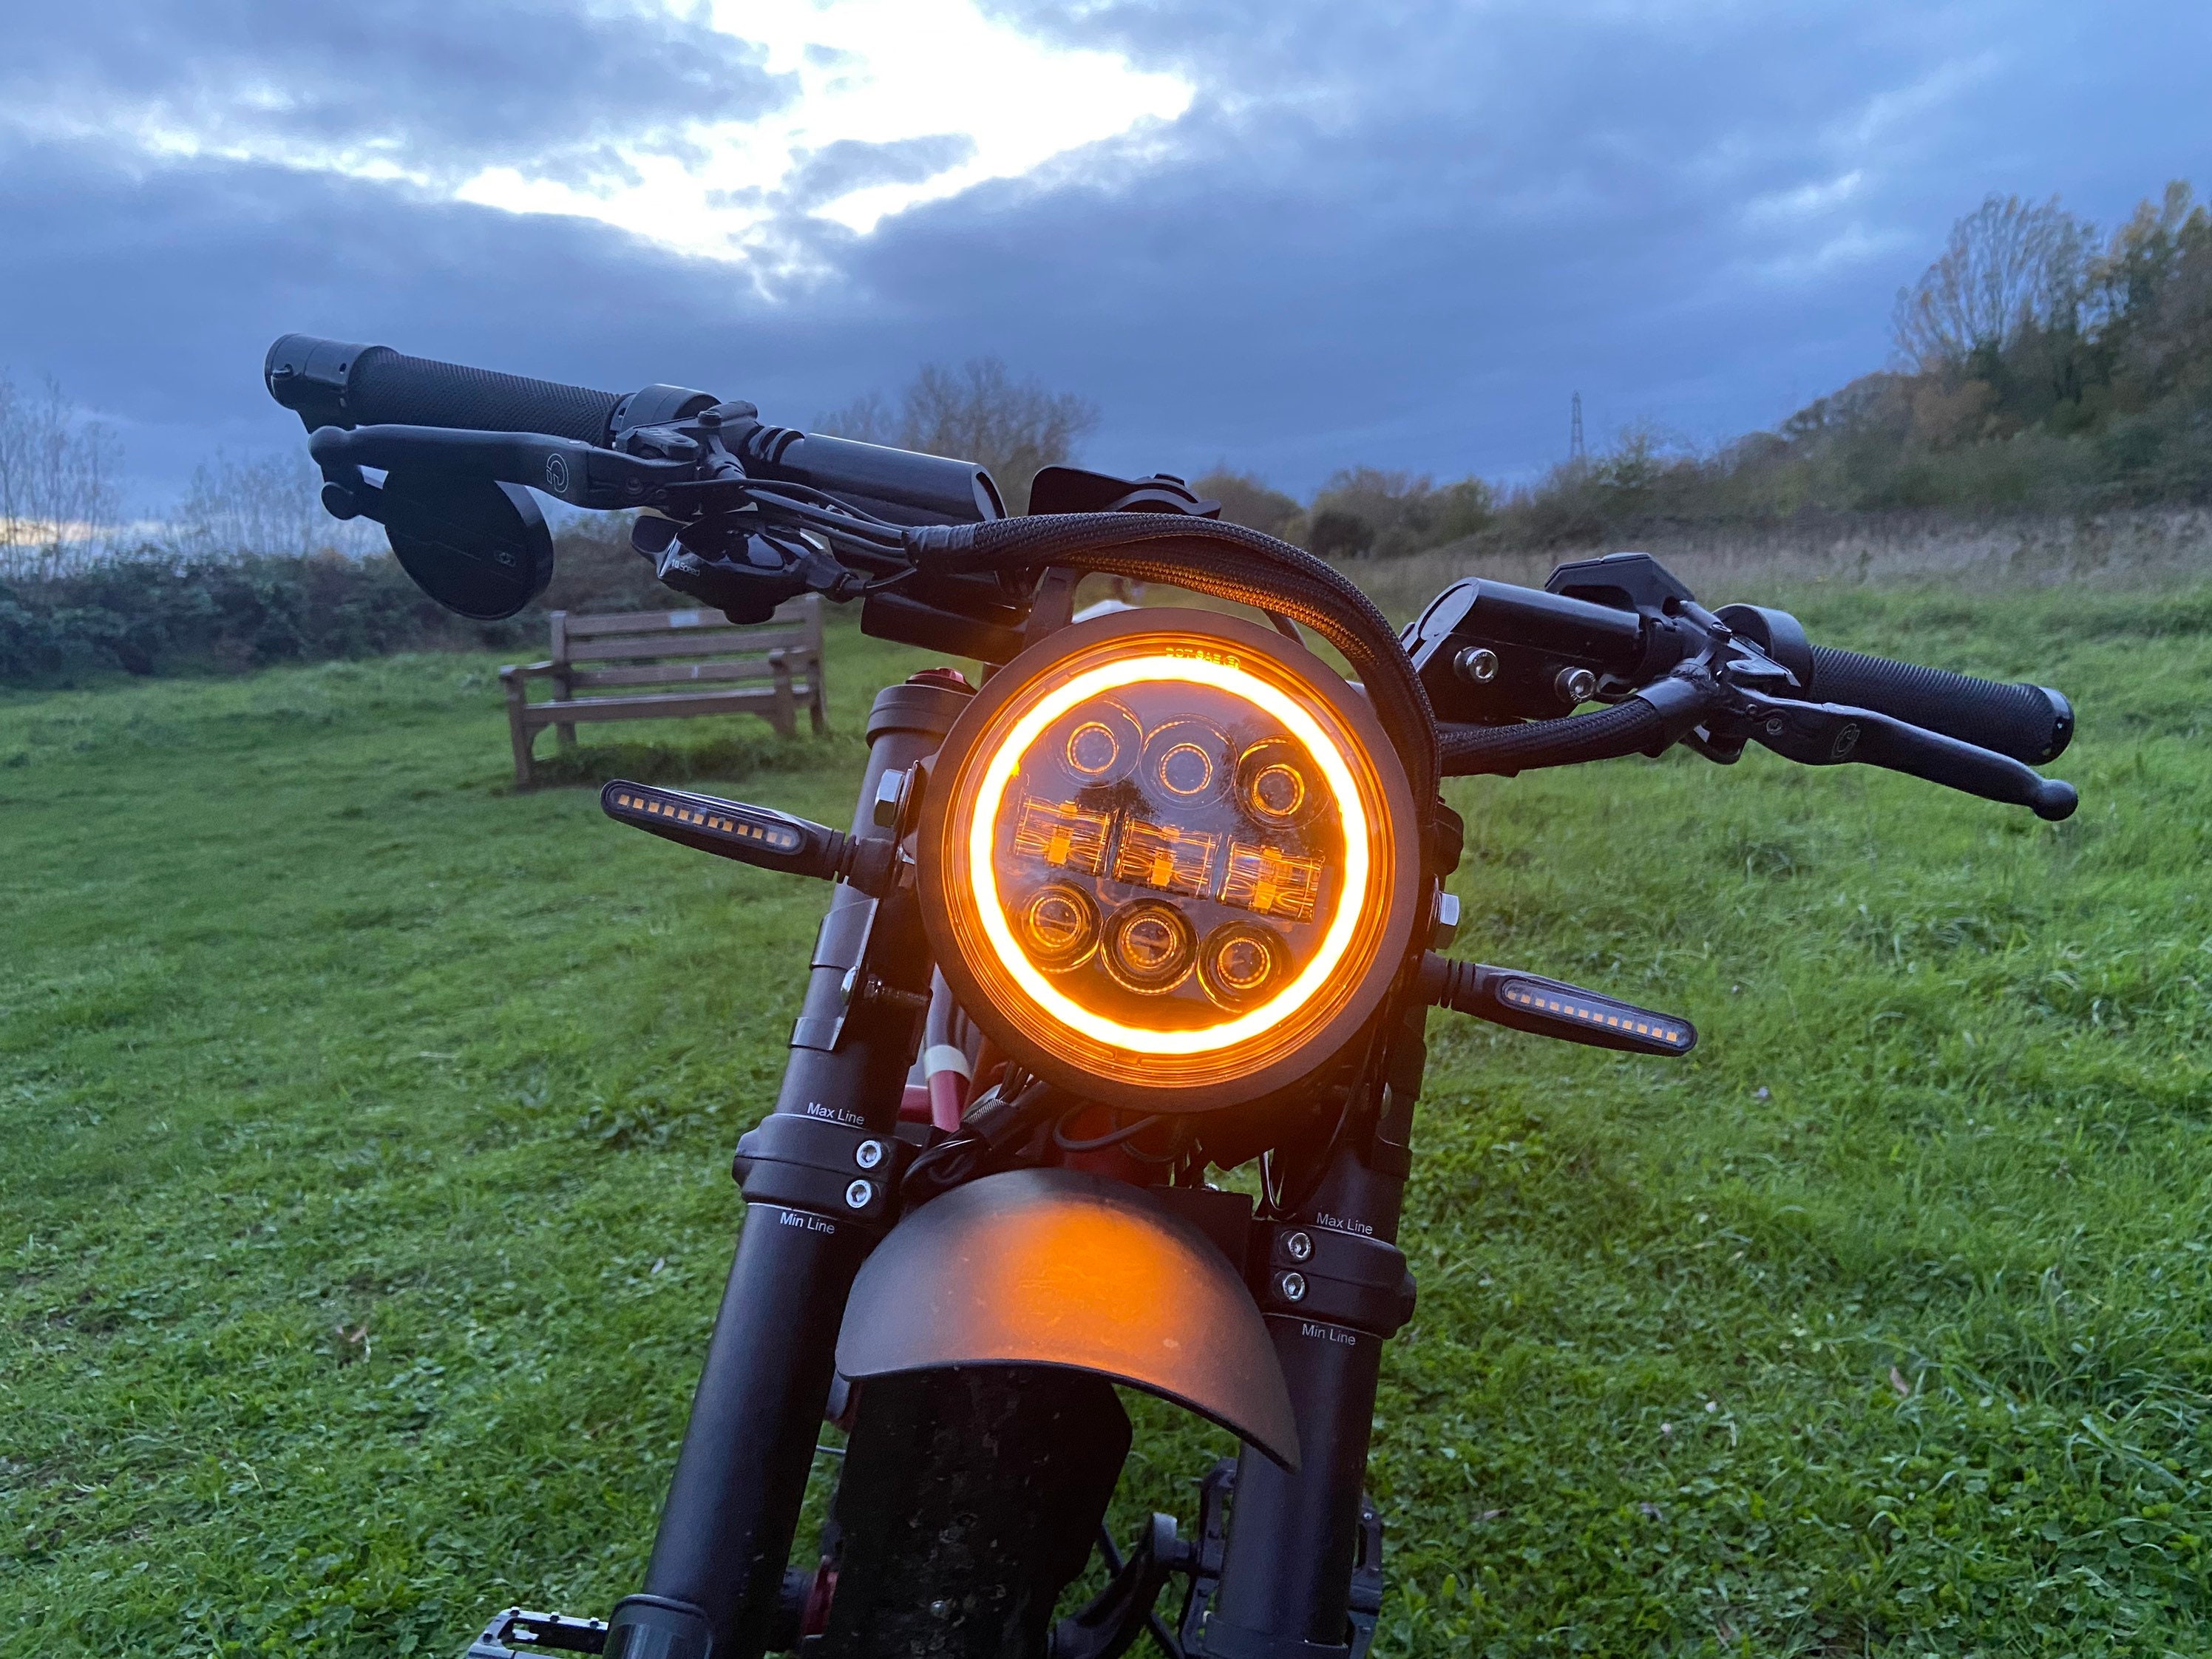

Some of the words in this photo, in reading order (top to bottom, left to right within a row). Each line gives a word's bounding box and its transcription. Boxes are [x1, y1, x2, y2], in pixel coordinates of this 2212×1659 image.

[807, 1102, 835, 1119] Max
[838, 1108, 865, 1125] Line
[780, 1212, 804, 1227] Min
[807, 1217, 835, 1234] Line
[1317, 1212, 1343, 1228] Max
[1347, 1218, 1373, 1235] Line
[1302, 1323, 1326, 1339] Min
[1329, 1329, 1356, 1346] Line
